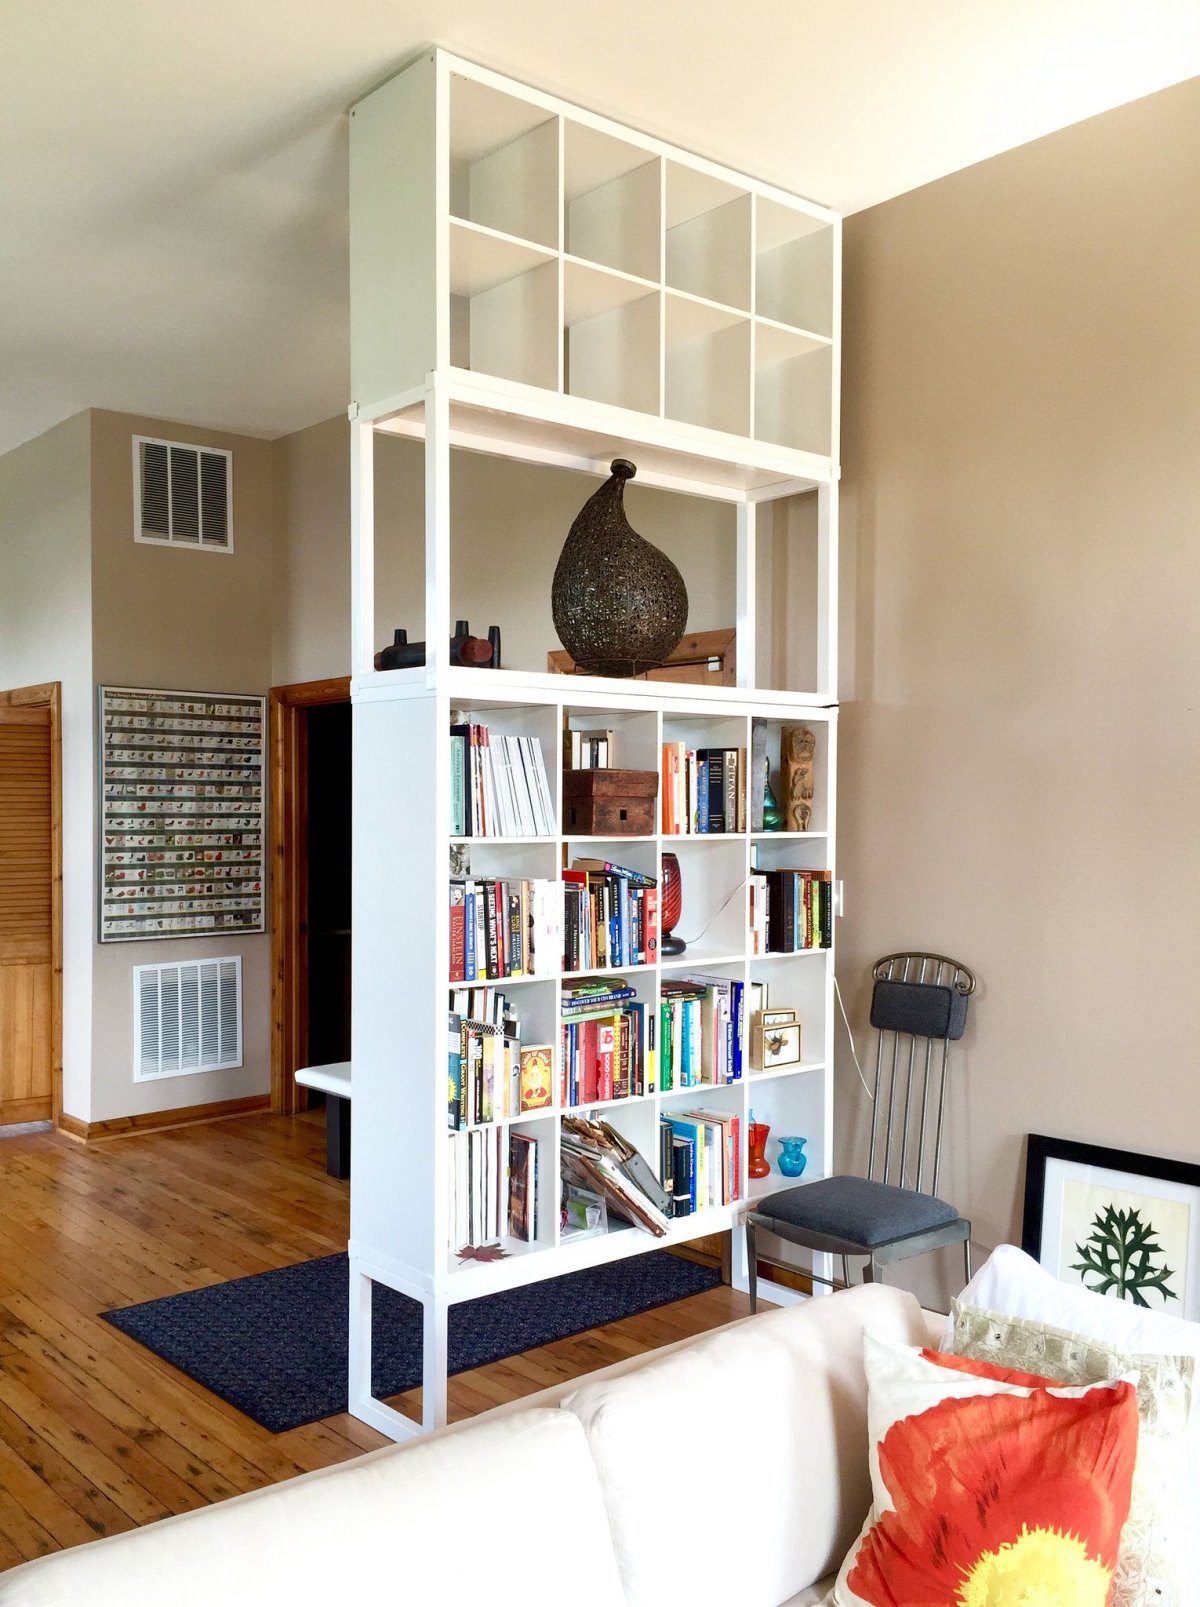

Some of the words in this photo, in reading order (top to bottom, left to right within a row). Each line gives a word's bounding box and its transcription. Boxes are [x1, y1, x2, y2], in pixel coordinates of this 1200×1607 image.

[488, 893, 496, 919] SEEING
[455, 916, 463, 965] EINSTEIN
[489, 919, 497, 946] WHAT'S
[490, 948, 498, 963] NEXT
[571, 998, 590, 1007] DISCOVER
[608, 993, 622, 1001] BRAND
